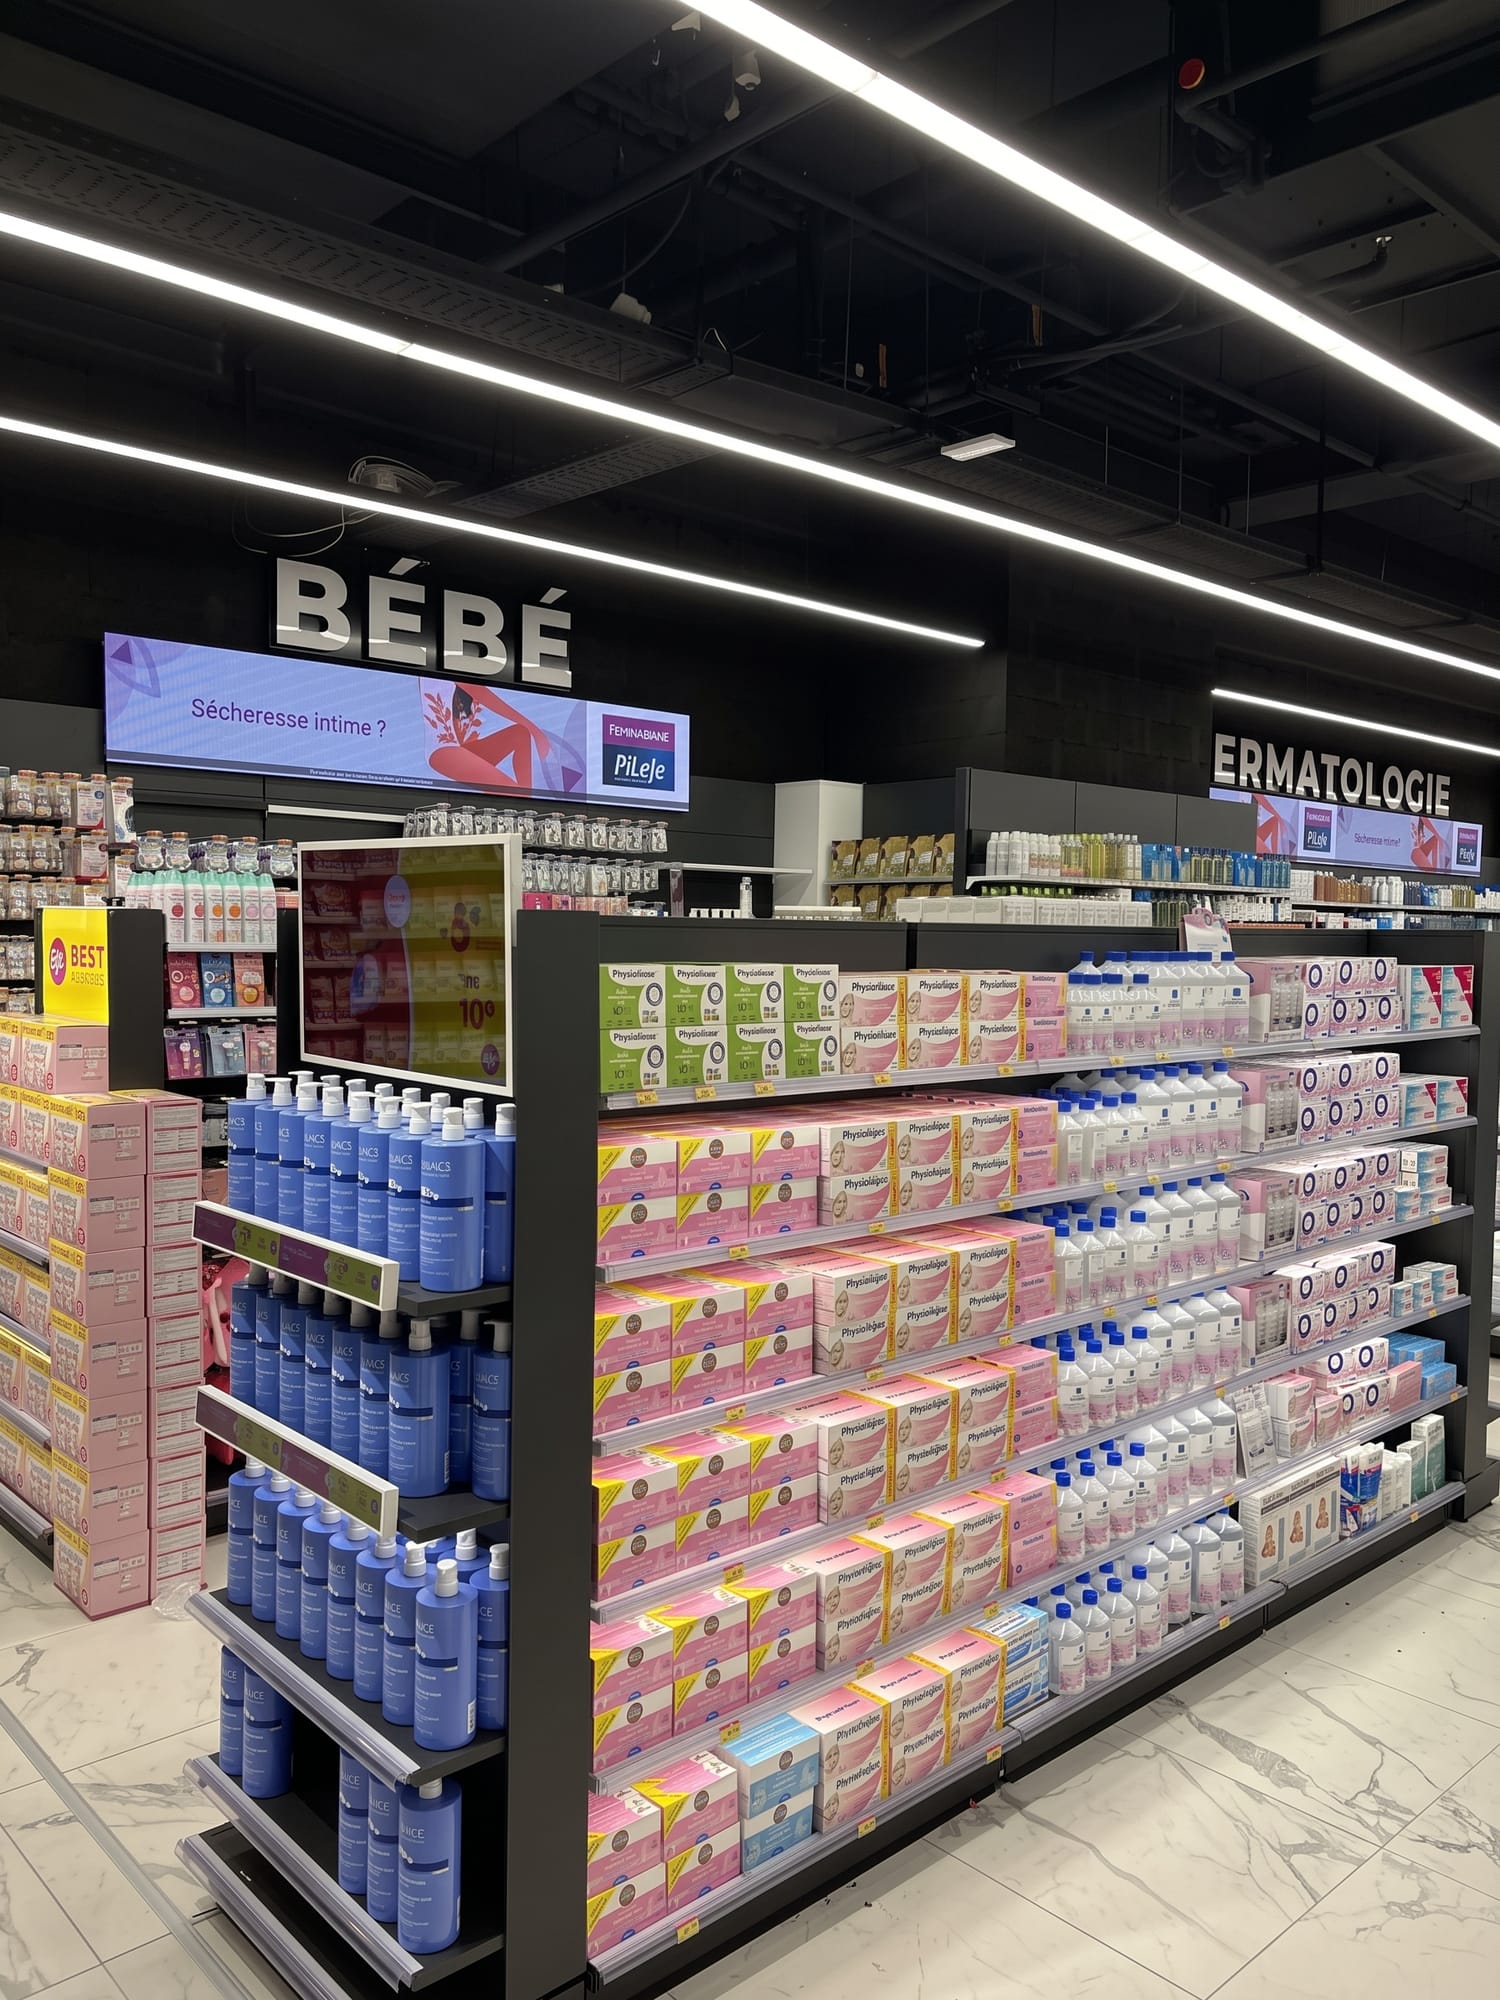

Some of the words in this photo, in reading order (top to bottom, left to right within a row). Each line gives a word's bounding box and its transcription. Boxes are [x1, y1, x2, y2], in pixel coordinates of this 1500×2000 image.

[276, 557, 572, 688] BÉBÉ
[191, 698, 308, 728] Sécheresse
[314, 711, 371, 736] intime
[377, 719, 386, 737] ?
[609, 724, 669, 742] FEMINABIANE
[614, 754, 665, 784] PiLeJe
[71, 944, 104, 968] BEST
